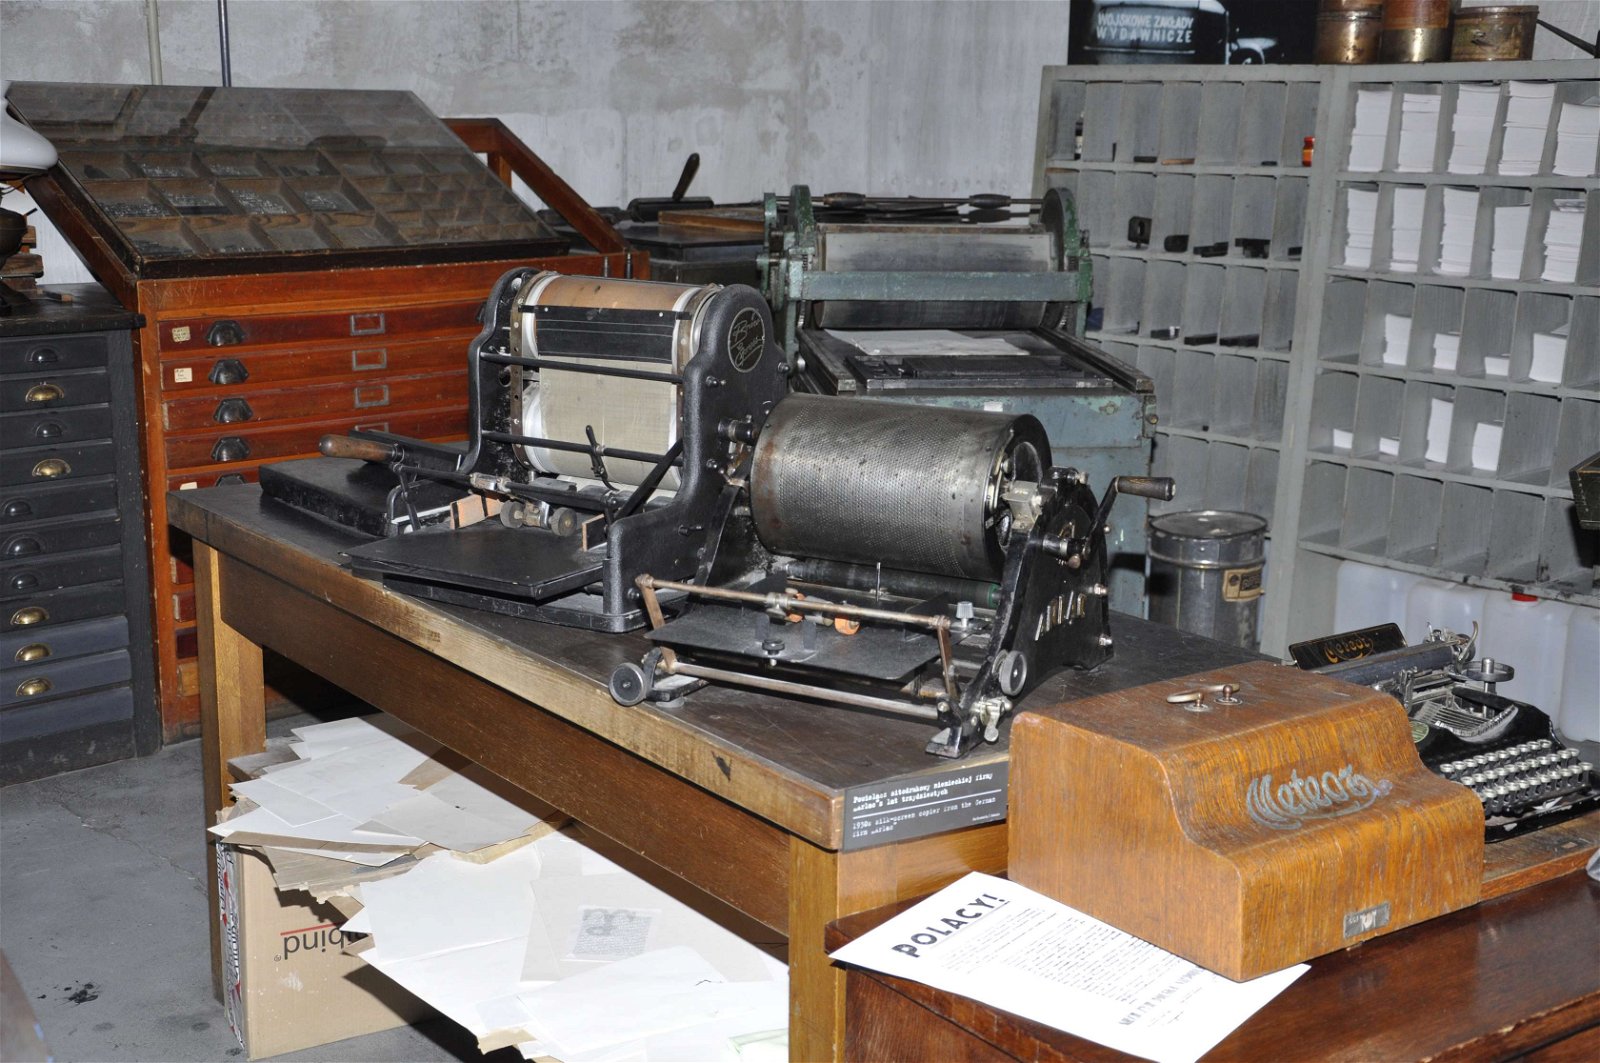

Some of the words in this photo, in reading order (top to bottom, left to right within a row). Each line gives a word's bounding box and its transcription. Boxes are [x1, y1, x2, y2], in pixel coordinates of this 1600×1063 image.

[1096, 25, 1193, 43] WYDAWNICZE
[1098, 12, 1151, 28] WOJSKOWE
[1246, 764, 1377, 830] Meteor
[891, 893, 1006, 959] POLACY!
